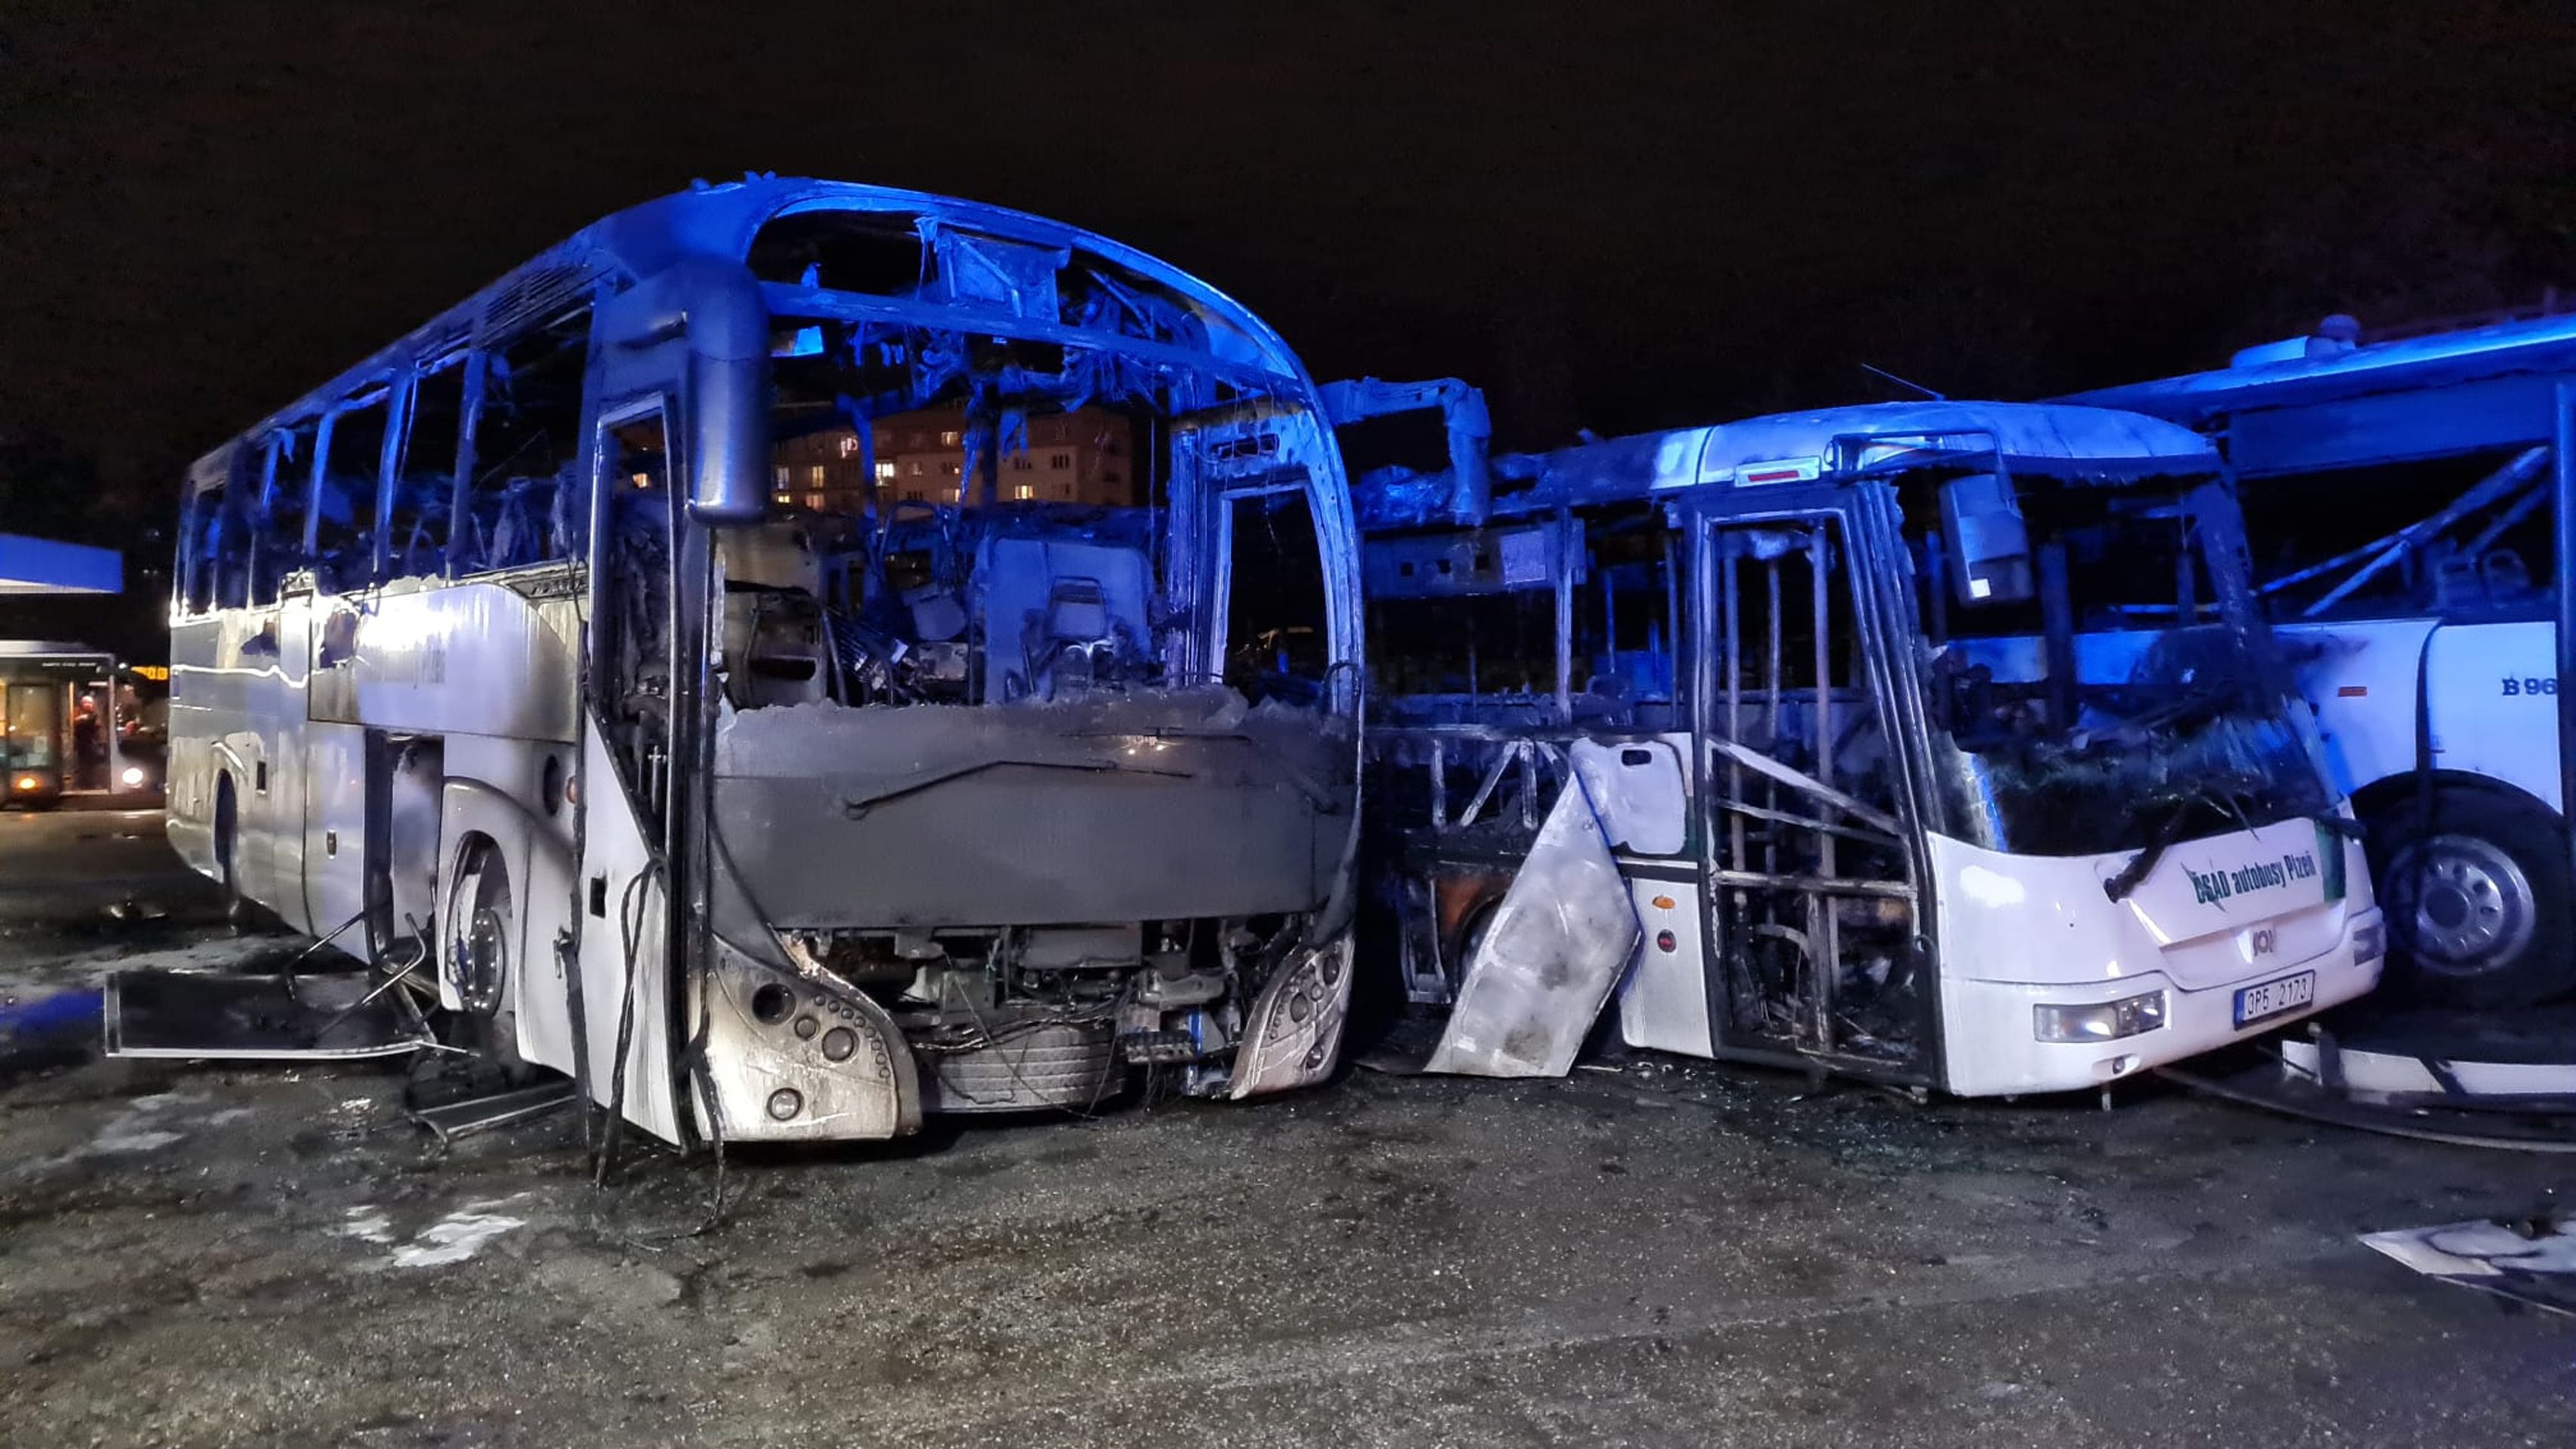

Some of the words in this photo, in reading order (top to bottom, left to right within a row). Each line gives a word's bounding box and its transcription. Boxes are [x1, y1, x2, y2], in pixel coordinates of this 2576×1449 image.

[2232, 862, 2286, 894] autobusy
[2284, 851, 2316, 881] Plzeň
[2248, 987, 2270, 1015] 3P5
[2278, 977, 2307, 1006] 2173
